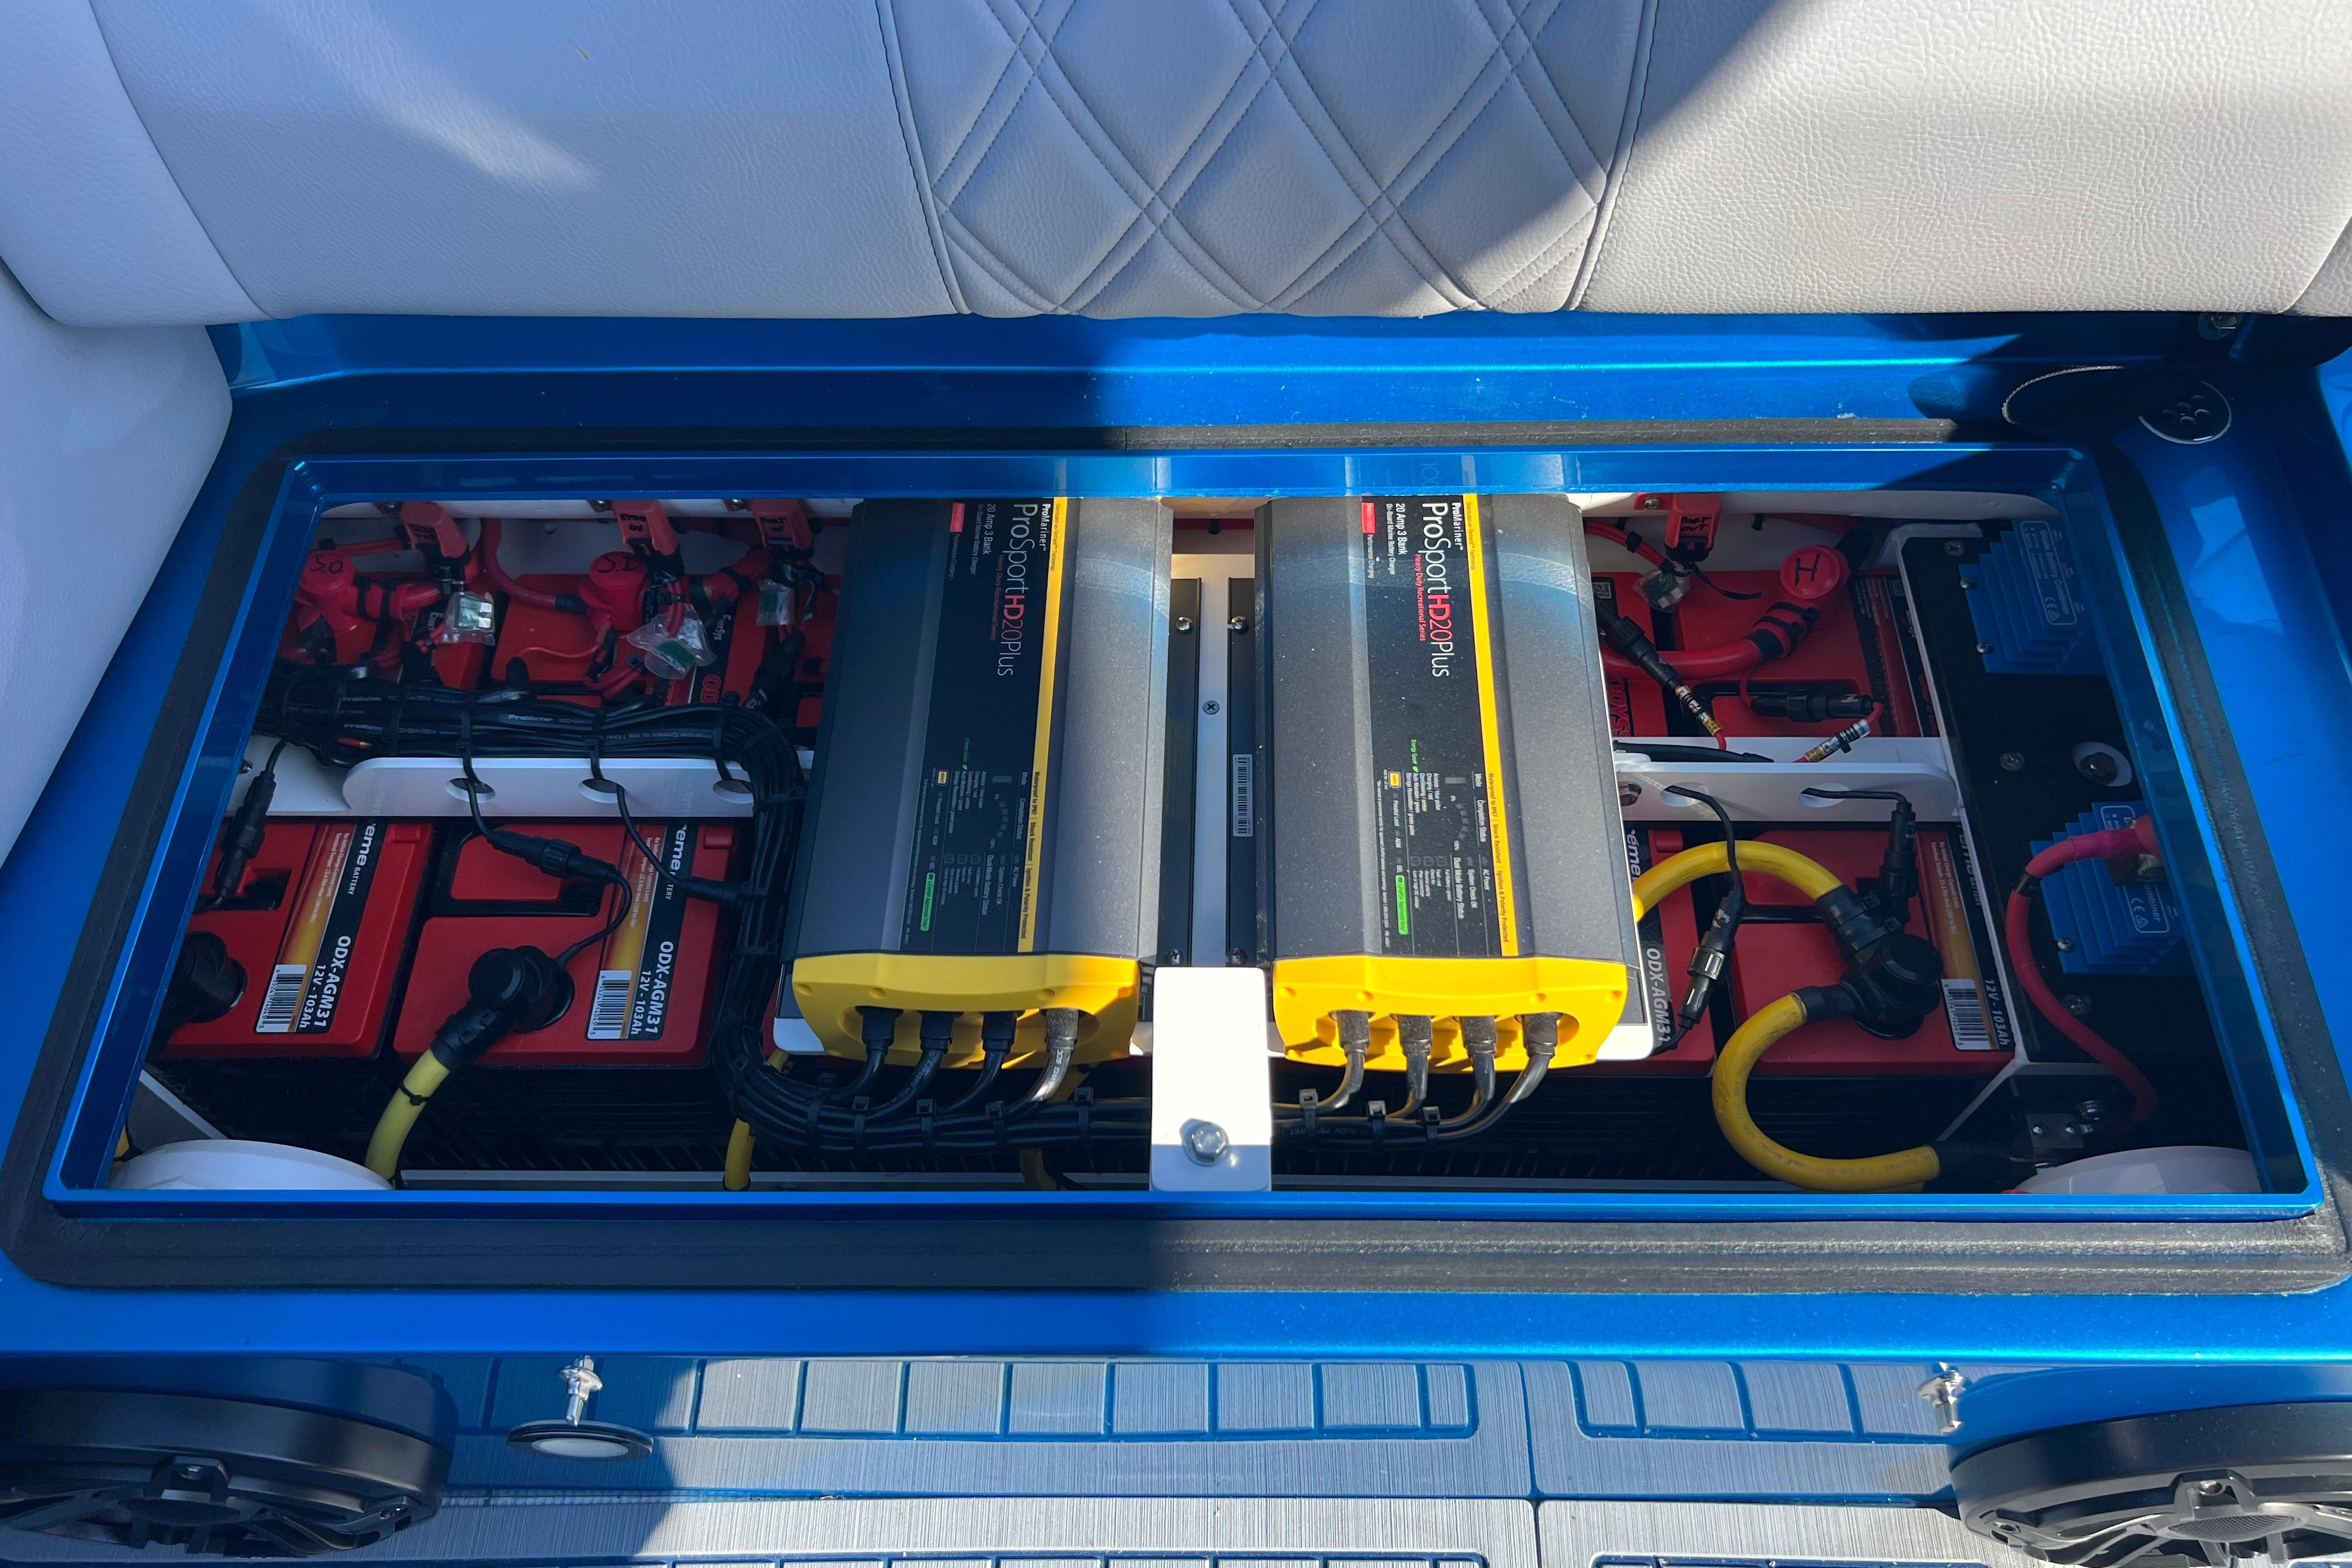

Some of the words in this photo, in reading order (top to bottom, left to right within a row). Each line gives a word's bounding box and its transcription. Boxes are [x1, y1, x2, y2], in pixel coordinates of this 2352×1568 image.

[987, 503, 996, 512] 20
[1396, 503, 1405, 512] 20
[985, 513, 995, 529] Amp
[1395, 513, 1405, 529] Amp
[1679, 524, 1708, 532] OUT
[1681, 516, 1713, 524] PORT
[951, 534, 960, 559] Performance
[971, 540, 980, 556] Battery
[983, 537, 993, 555] Bank
[1398, 537, 1408, 555] Bank
[949, 559, 957, 578] Charging
[970, 557, 978, 575] Charger
[995, 555, 1004, 572] Heavy
[1794, 553, 1821, 586] H
[2040, 530, 2050, 551] Diode
[2045, 552, 2058, 578] Battery
[2054, 579, 2070, 615] Combiner
[992, 587, 1001, 622] Recreational
[1417, 587, 1425, 622] Recreational
[713, 614, 732, 640] EnerSys
[1419, 624, 1427, 641] Series
[1032, 772, 1040, 797] Waterproof
[1017, 798, 1026, 823] Completion
[1476, 800, 1486, 826] Completion
[334, 852, 344, 867] Charge
[985, 855, 994, 881] Dual-Mode
[997, 866, 1005, 883] System
[1467, 869, 1475, 886] System
[1943, 862, 1952, 878] Charge
[348, 867, 361, 895] BATTERY
[982, 881, 991, 899] Battery
[1455, 884, 1463, 902] Battery
[2144, 884, 2161, 922] ombiner
[981, 900, 989, 916] Status
[313, 964, 327, 985] 12V
[313, 936, 351, 1028] ODX-AGM31
[638, 970, 652, 991] 12V
[645, 940, 674, 1034] ODX-AGM31
[1646, 948, 1671, 1042] ODX-AGM31
[1985, 979, 1999, 999] 12V
[299, 993, 318, 1028] 103Ah
[630, 999, 646, 1035] 103Ah
[1991, 1010, 2011, 1045] 103Ah
